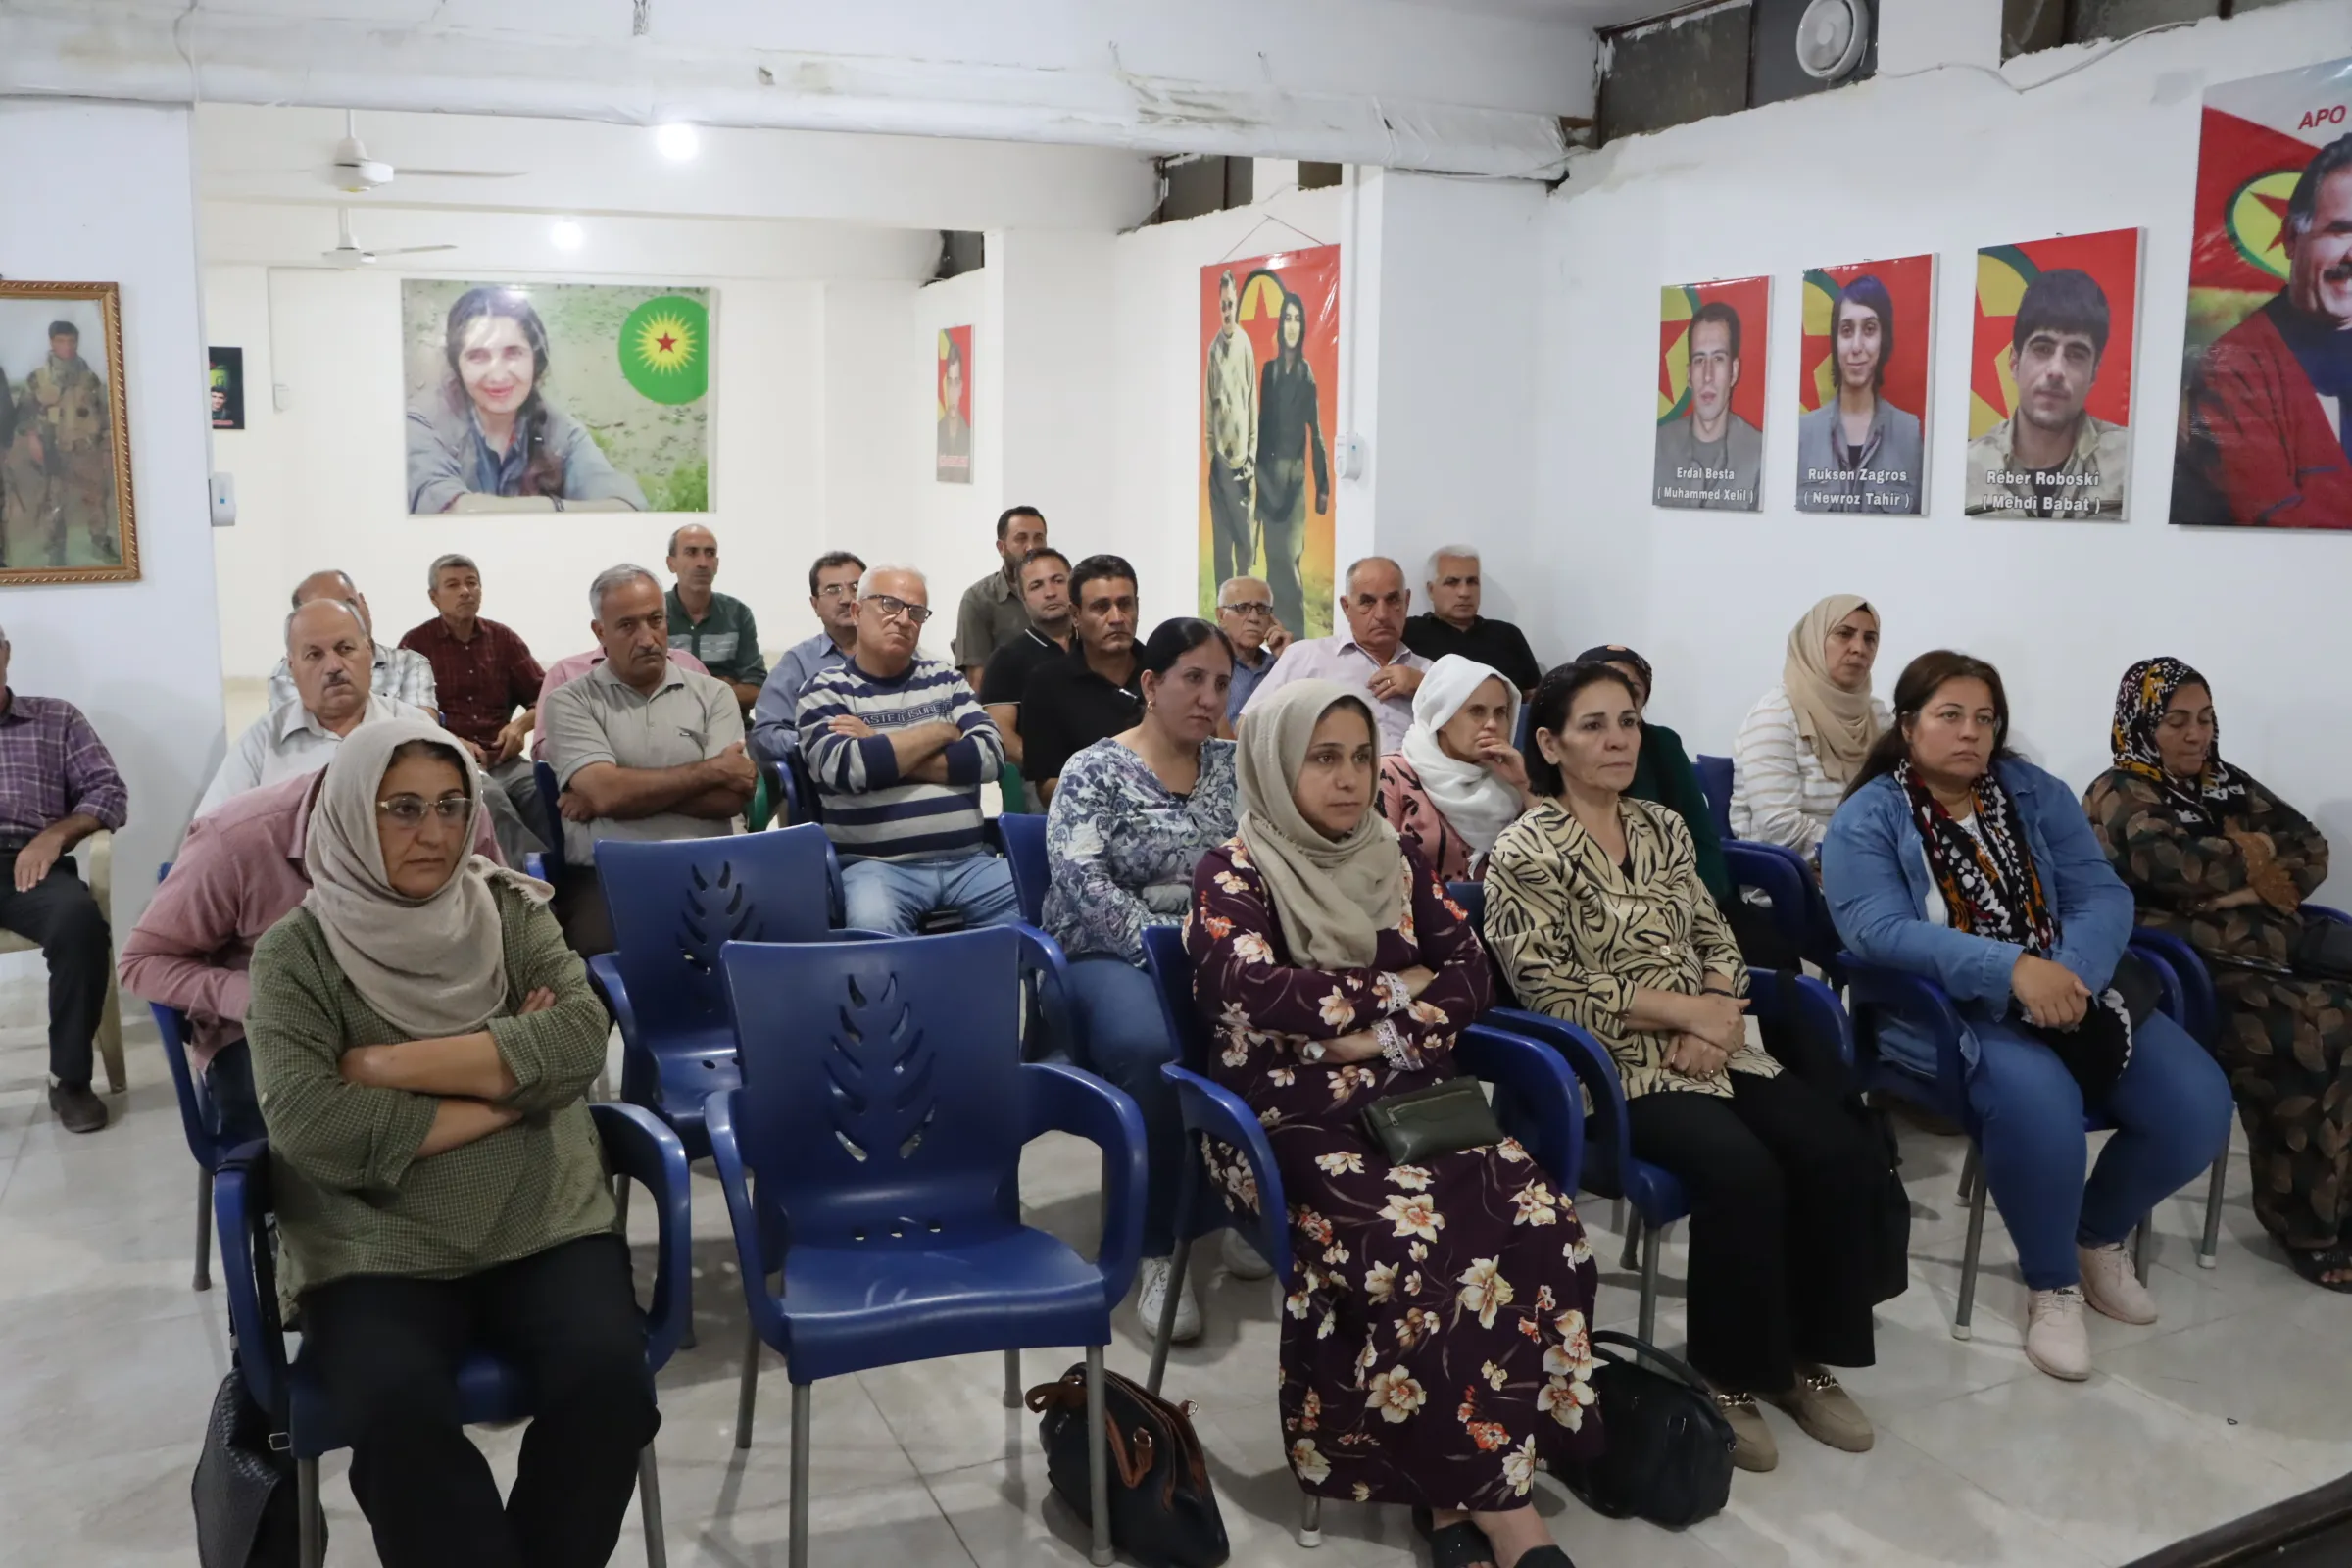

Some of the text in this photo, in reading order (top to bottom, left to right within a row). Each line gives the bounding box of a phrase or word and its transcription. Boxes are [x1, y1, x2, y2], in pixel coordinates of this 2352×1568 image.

[2297, 105, 2347, 130] APO
[1676, 466, 1735, 479] Erdal Besta
[1808, 468, 1907, 484] Ruksen Zagros
[1986, 470, 2031, 484] Rêber
[1664, 487, 1720, 500] Muhammed
[1813, 492, 1860, 504] Newroz
[1866, 492, 1900, 506] Tahir
[2043, 497, 2089, 510] Babat
